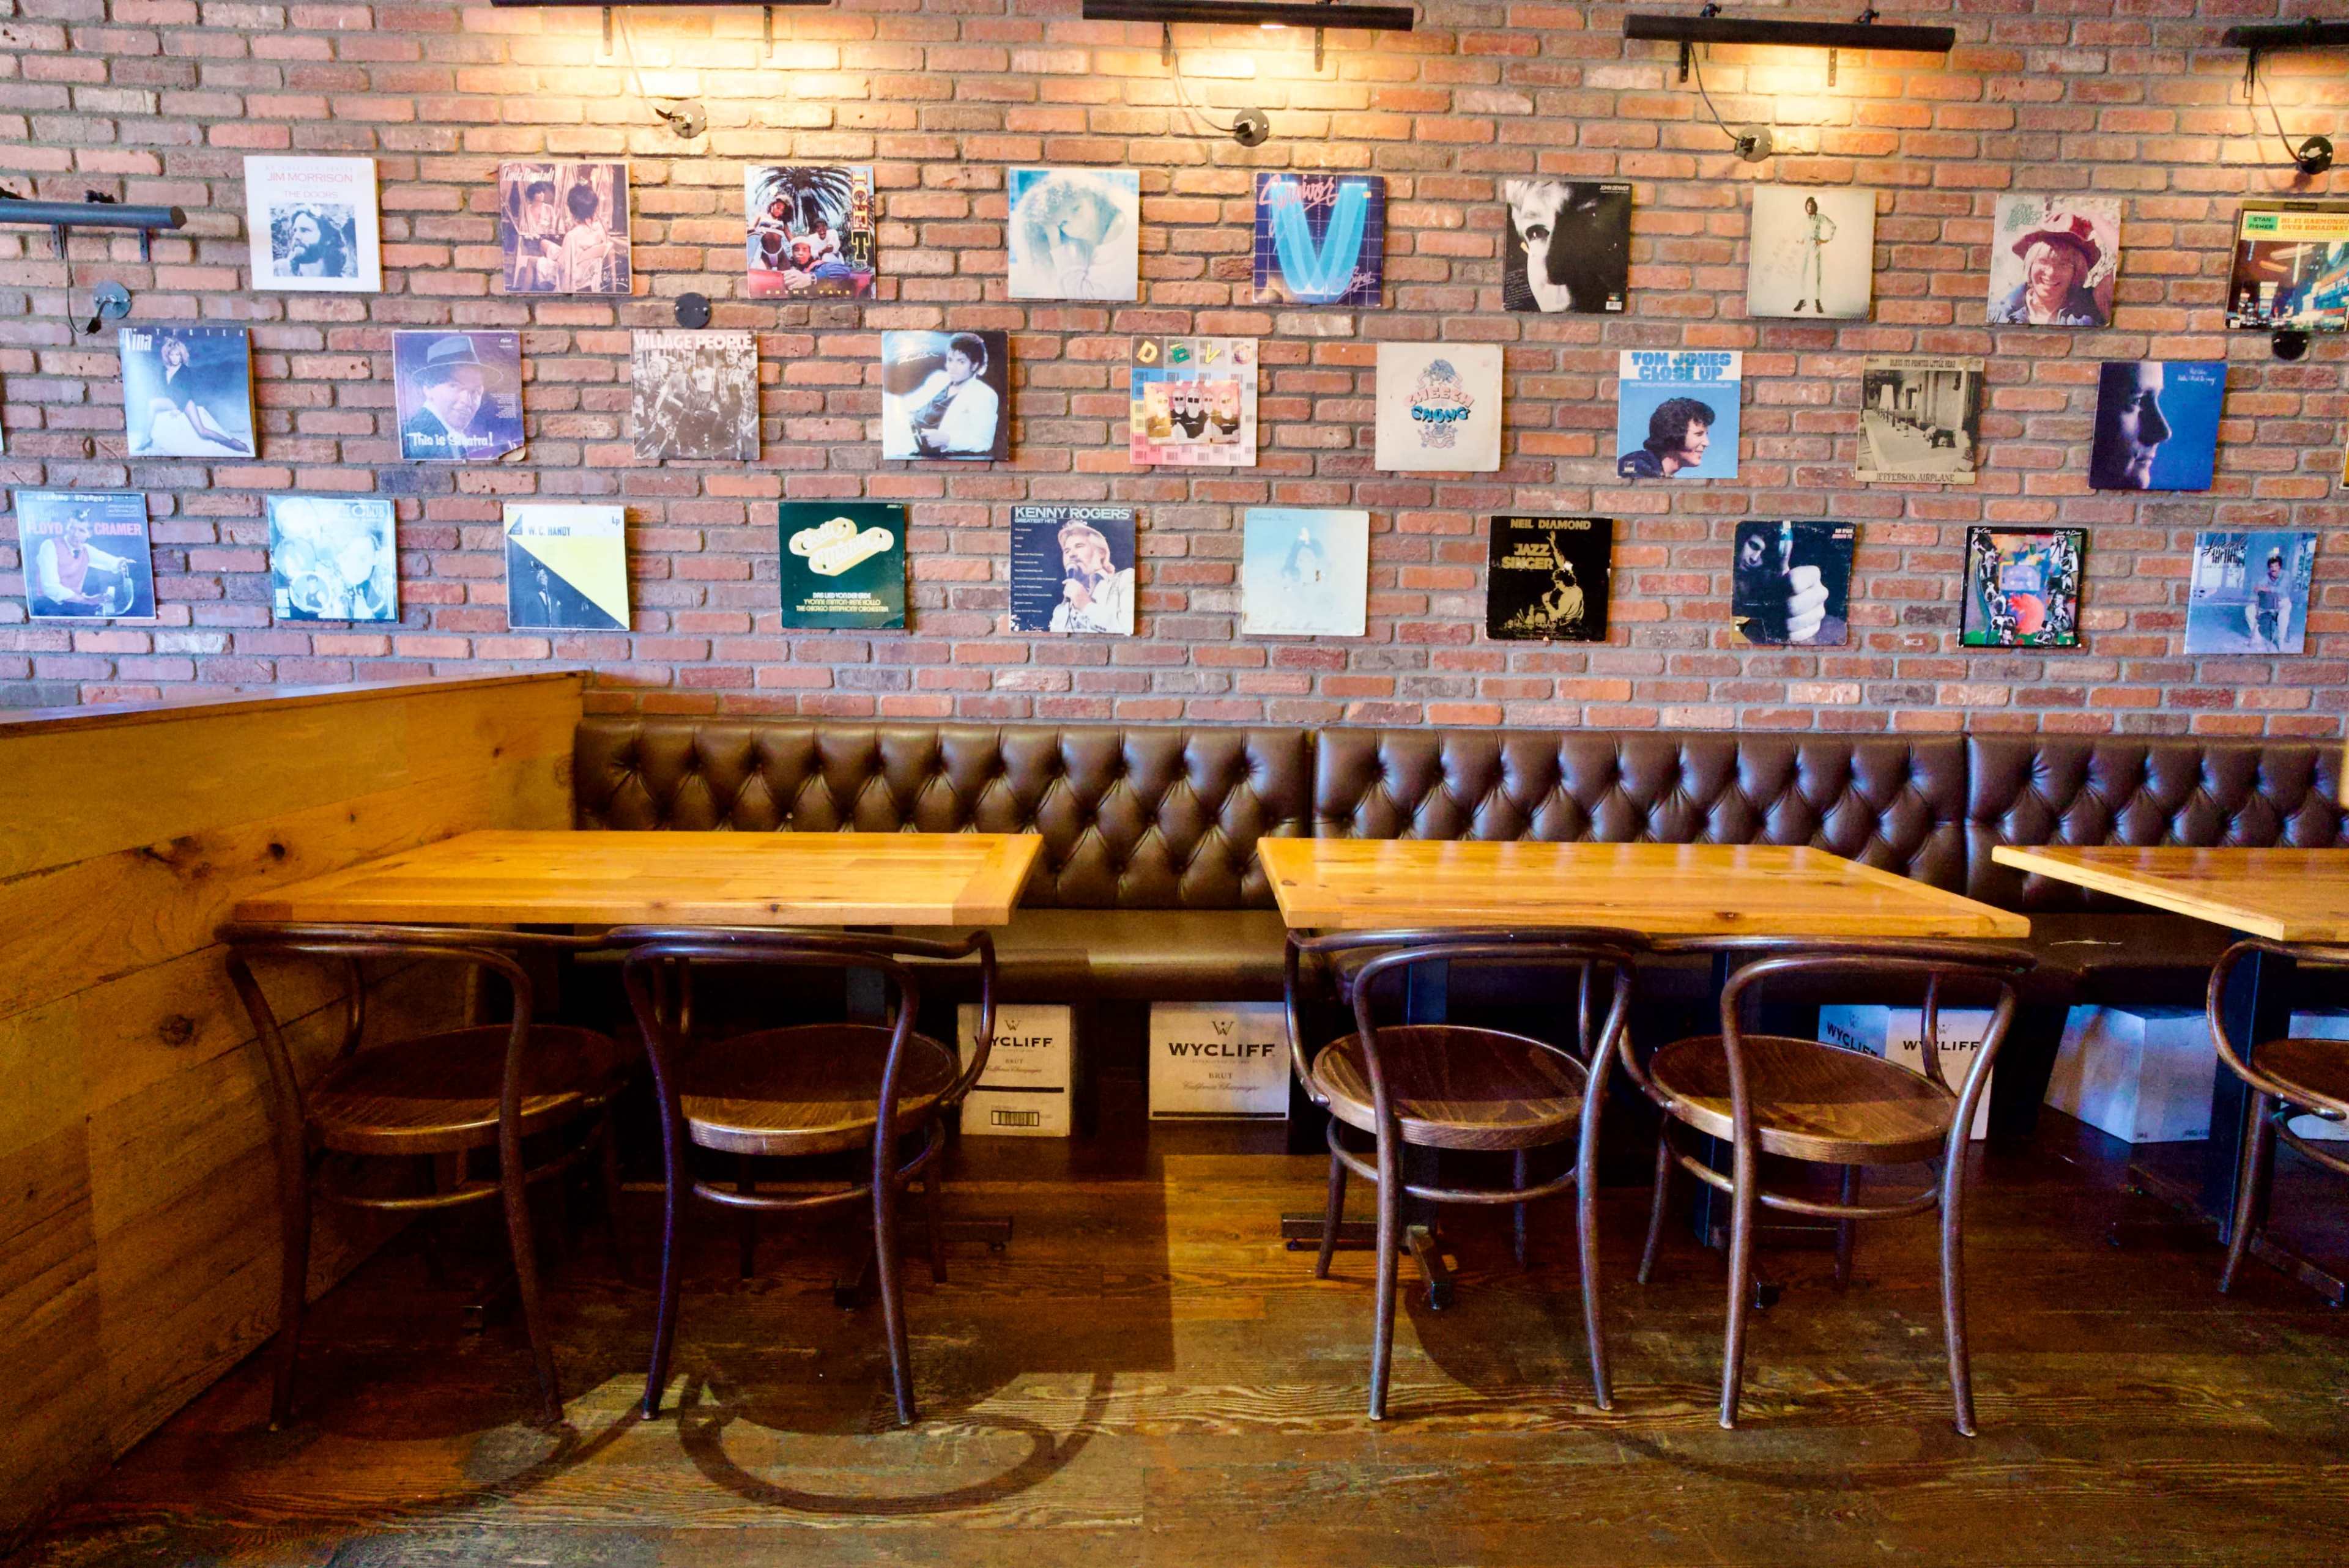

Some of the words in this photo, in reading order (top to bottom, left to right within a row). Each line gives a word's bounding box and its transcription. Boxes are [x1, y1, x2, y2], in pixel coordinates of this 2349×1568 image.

[267, 172, 286, 182] JIM
[288, 172, 353, 183] MORRISON
[1259, 173, 1339, 211] Survivor
[118, 328, 152, 351] Tina
[633, 333, 694, 350] VILLAGE
[694, 334, 752, 351] PEOPLE
[1631, 352, 1669, 366] TOM
[1672, 352, 1732, 366] JONES
[1638, 366, 1695, 382] CLOSE
[1698, 366, 1724, 382] UP
[1403, 385, 1475, 409] CHEECH
[1411, 405, 1471, 424] CHONG
[406, 432, 434, 446] This
[434, 434, 446, 446] is
[1876, 472, 1917, 482] JEFFERSON
[1917, 473, 1956, 483] AIRPLANE
[1014, 506, 1068, 519] KENNY
[1069, 508, 1132, 520] ROGERS'
[611, 516, 621, 526] Lp
[1510, 519, 1535, 530] NEIL
[1537, 519, 1592, 531] DIAMOND
[26, 522, 64, 535] FLOYD
[94, 522, 143, 536] CRAMER
[528, 526, 537, 536] W.
[538, 526, 546, 536] C.
[547, 526, 571, 536] HANDY
[1513, 542, 1551, 557] JAZZ
[1501, 556, 1554, 570] SINGER
[974, 1035, 1053, 1048] YCLIFF
[1168, 1042, 1275, 1057] WYCLIFF
